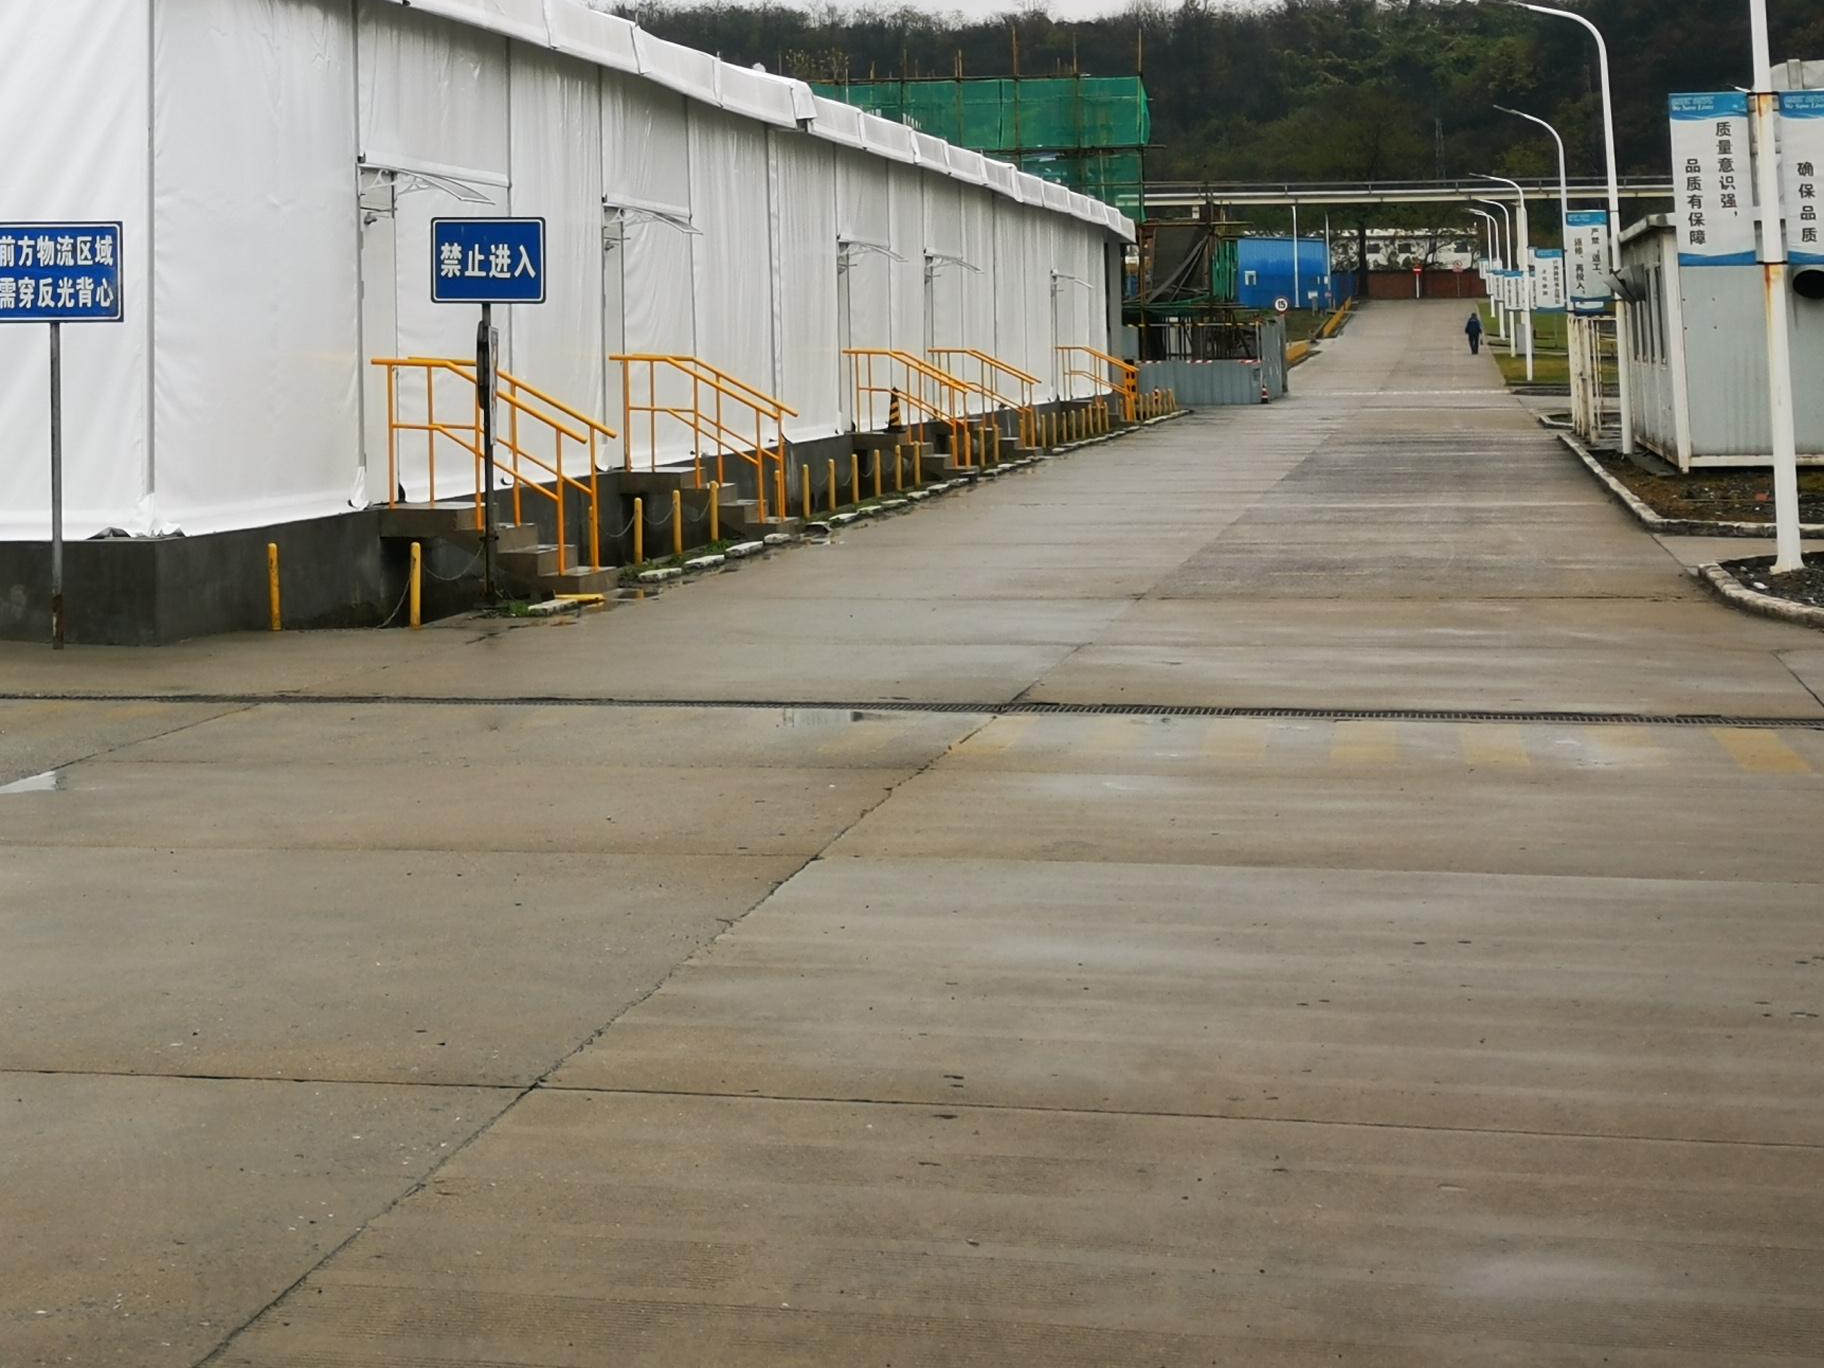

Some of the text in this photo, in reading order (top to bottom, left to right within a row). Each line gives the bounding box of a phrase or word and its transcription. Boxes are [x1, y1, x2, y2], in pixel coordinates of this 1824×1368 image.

[1685, 158, 1707, 245] 品质有保障
[1797, 161, 1818, 243] 确保品质
[440, 242, 536, 278] 禁止进入
